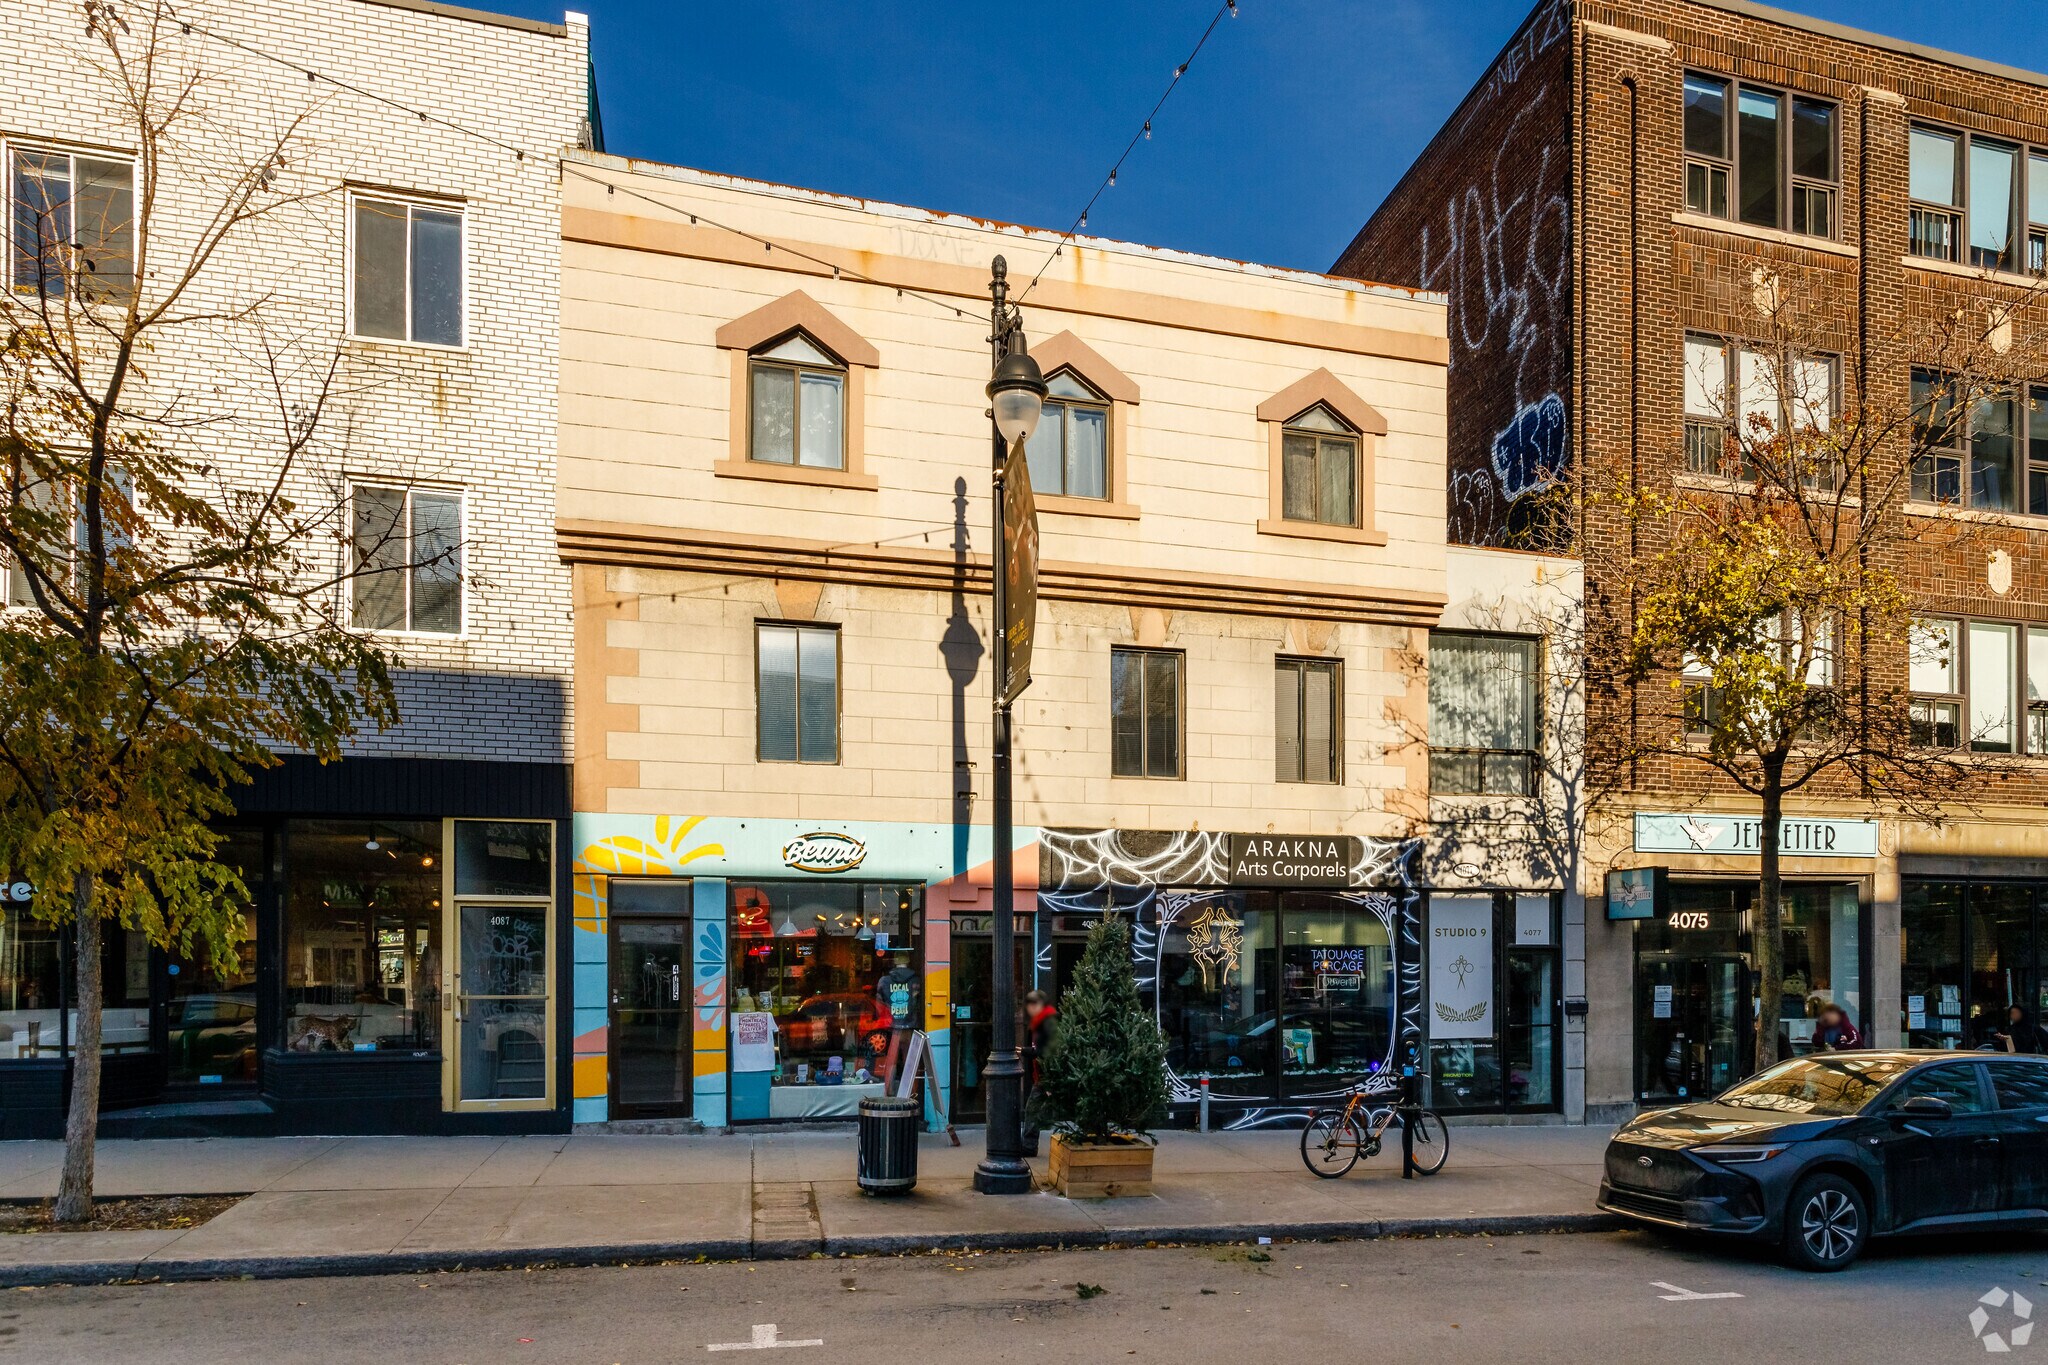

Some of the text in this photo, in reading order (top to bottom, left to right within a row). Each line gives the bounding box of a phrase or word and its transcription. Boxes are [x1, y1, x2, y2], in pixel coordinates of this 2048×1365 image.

[1783, 823, 1836, 851] ETTER
[1245, 840, 1338, 858] ARAKNA
[1236, 860, 1347, 881] Arts Corporels
[490, 916, 510, 926] 4087
[1668, 912, 1709, 929] 4075
[1434, 927, 1487, 937] STUDIO 9
[1523, 929, 1543, 937] 4077
[1311, 949, 1365, 960] TATOUAGE
[889, 983, 909, 993] LOCAL
